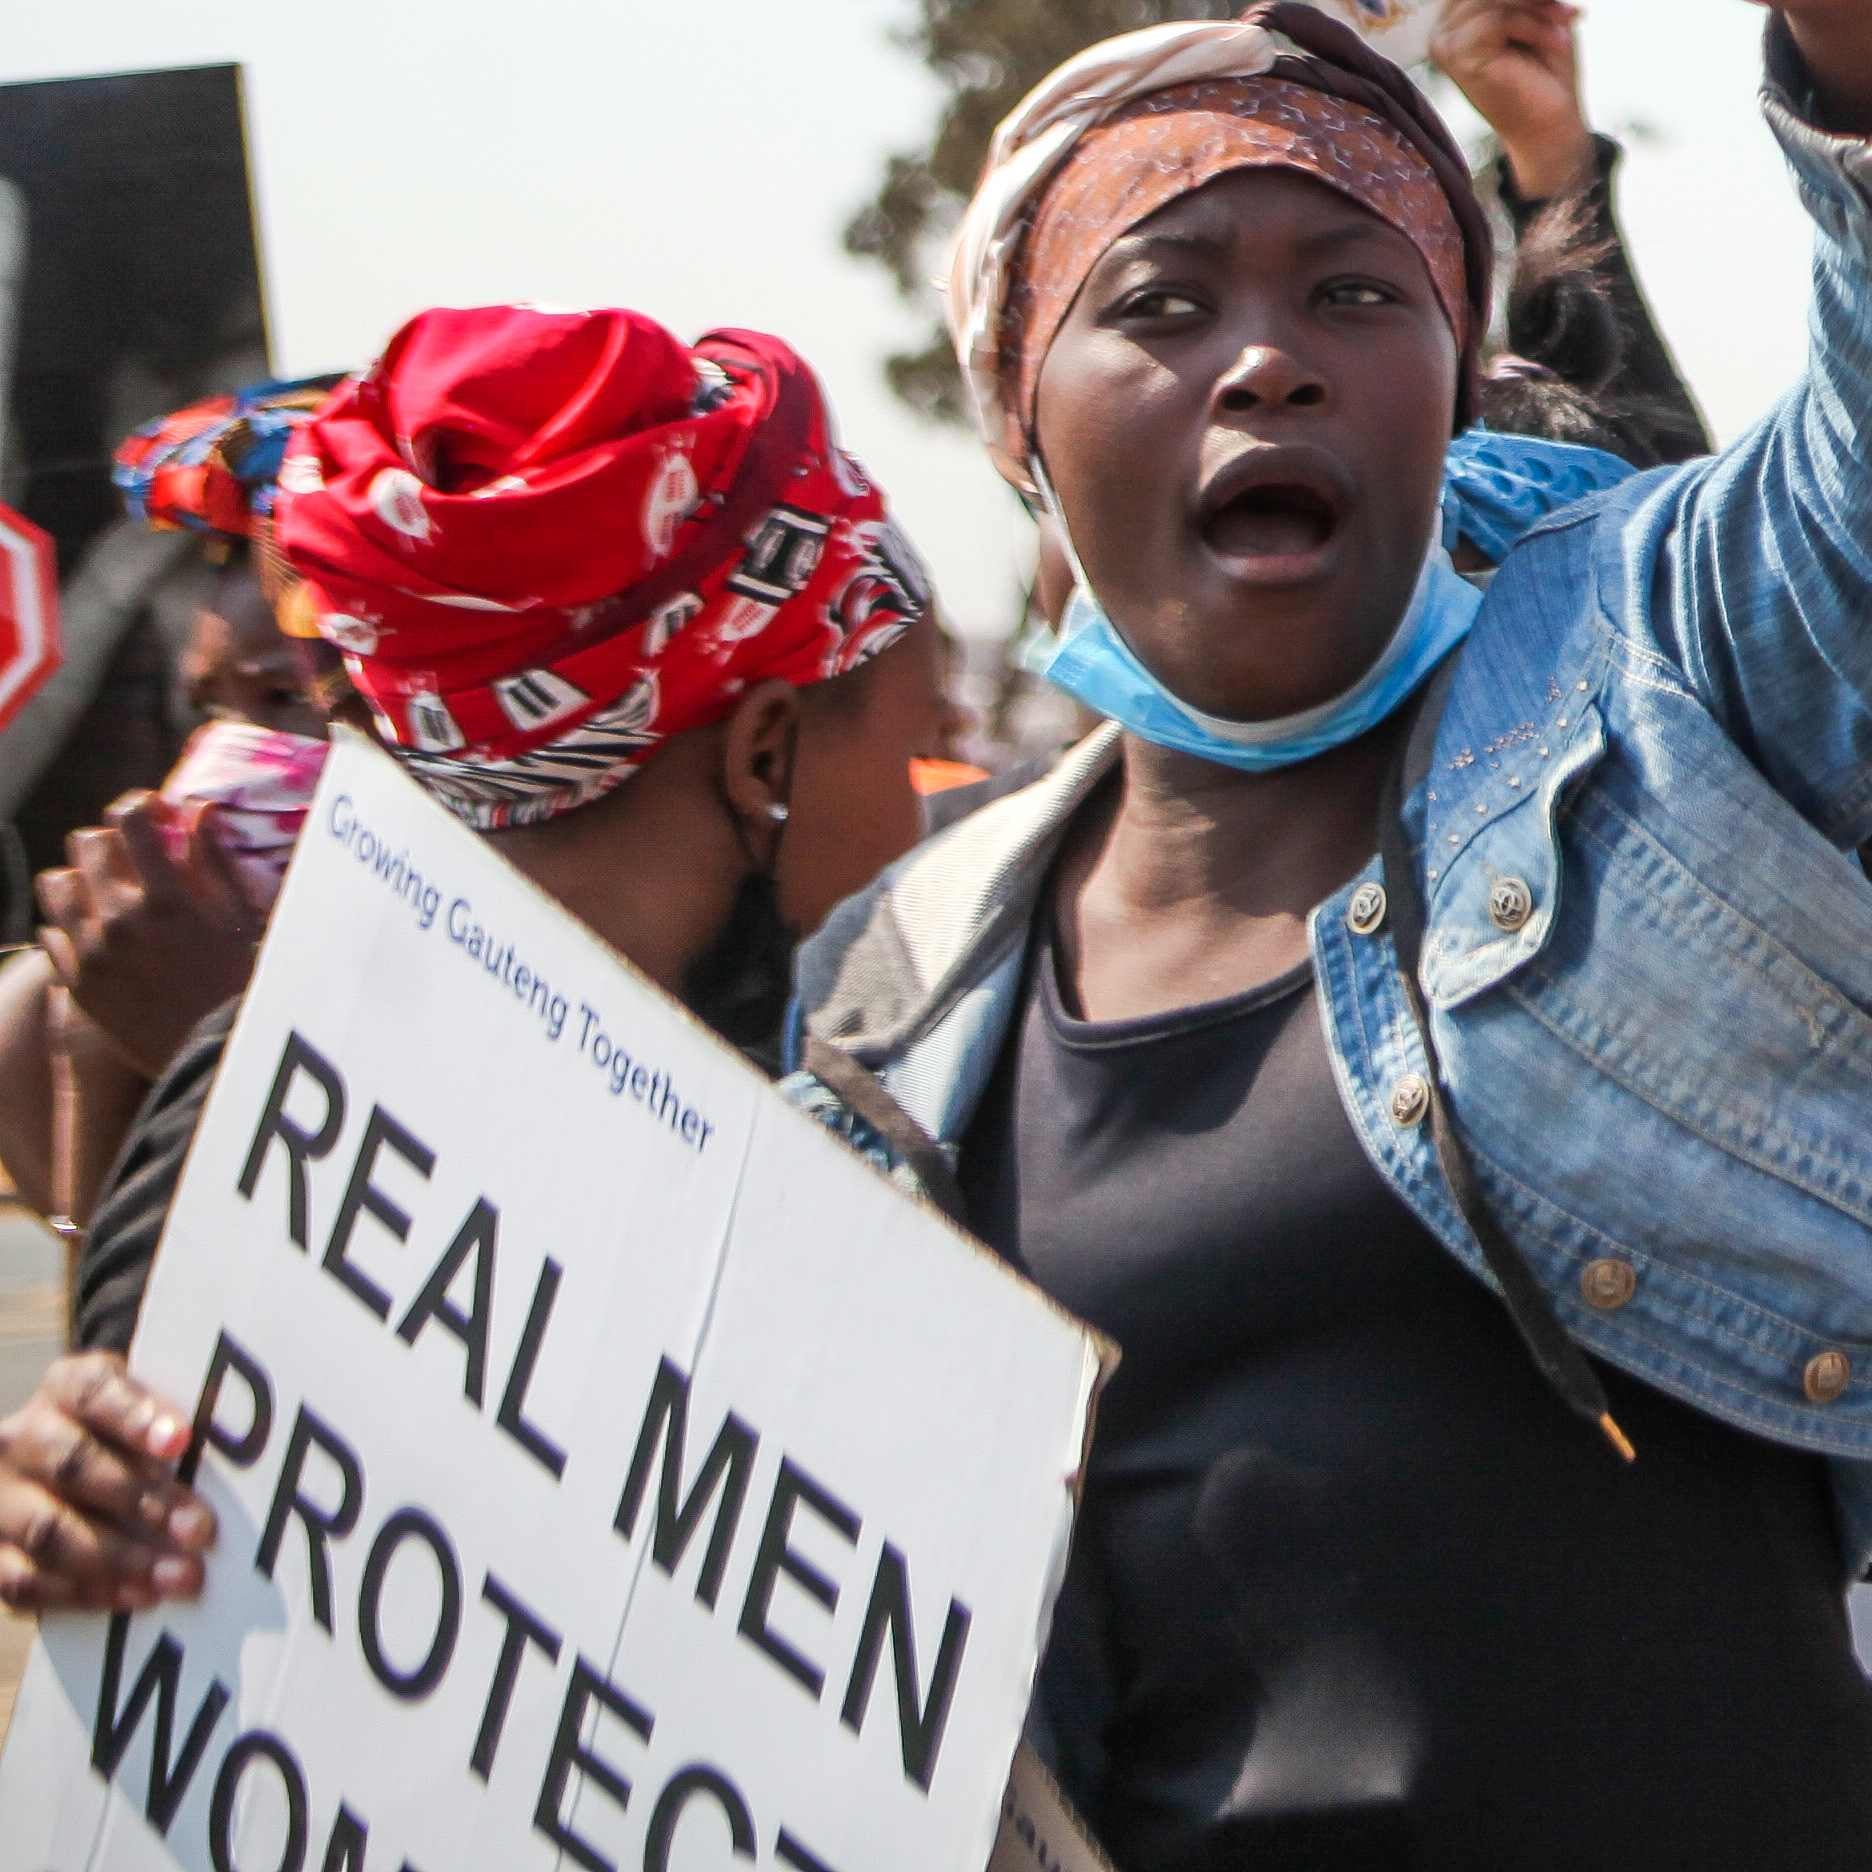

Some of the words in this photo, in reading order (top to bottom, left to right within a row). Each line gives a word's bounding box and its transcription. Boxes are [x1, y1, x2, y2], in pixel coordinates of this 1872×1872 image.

[329, 794, 441, 930] Growing
[447, 898, 571, 1041] Gauteng
[579, 1004, 716, 1153] Together
[174, 1328, 842, 1872] PROTEC
[237, 1027, 568, 1482] REAL
[613, 1352, 973, 1796] MEN
